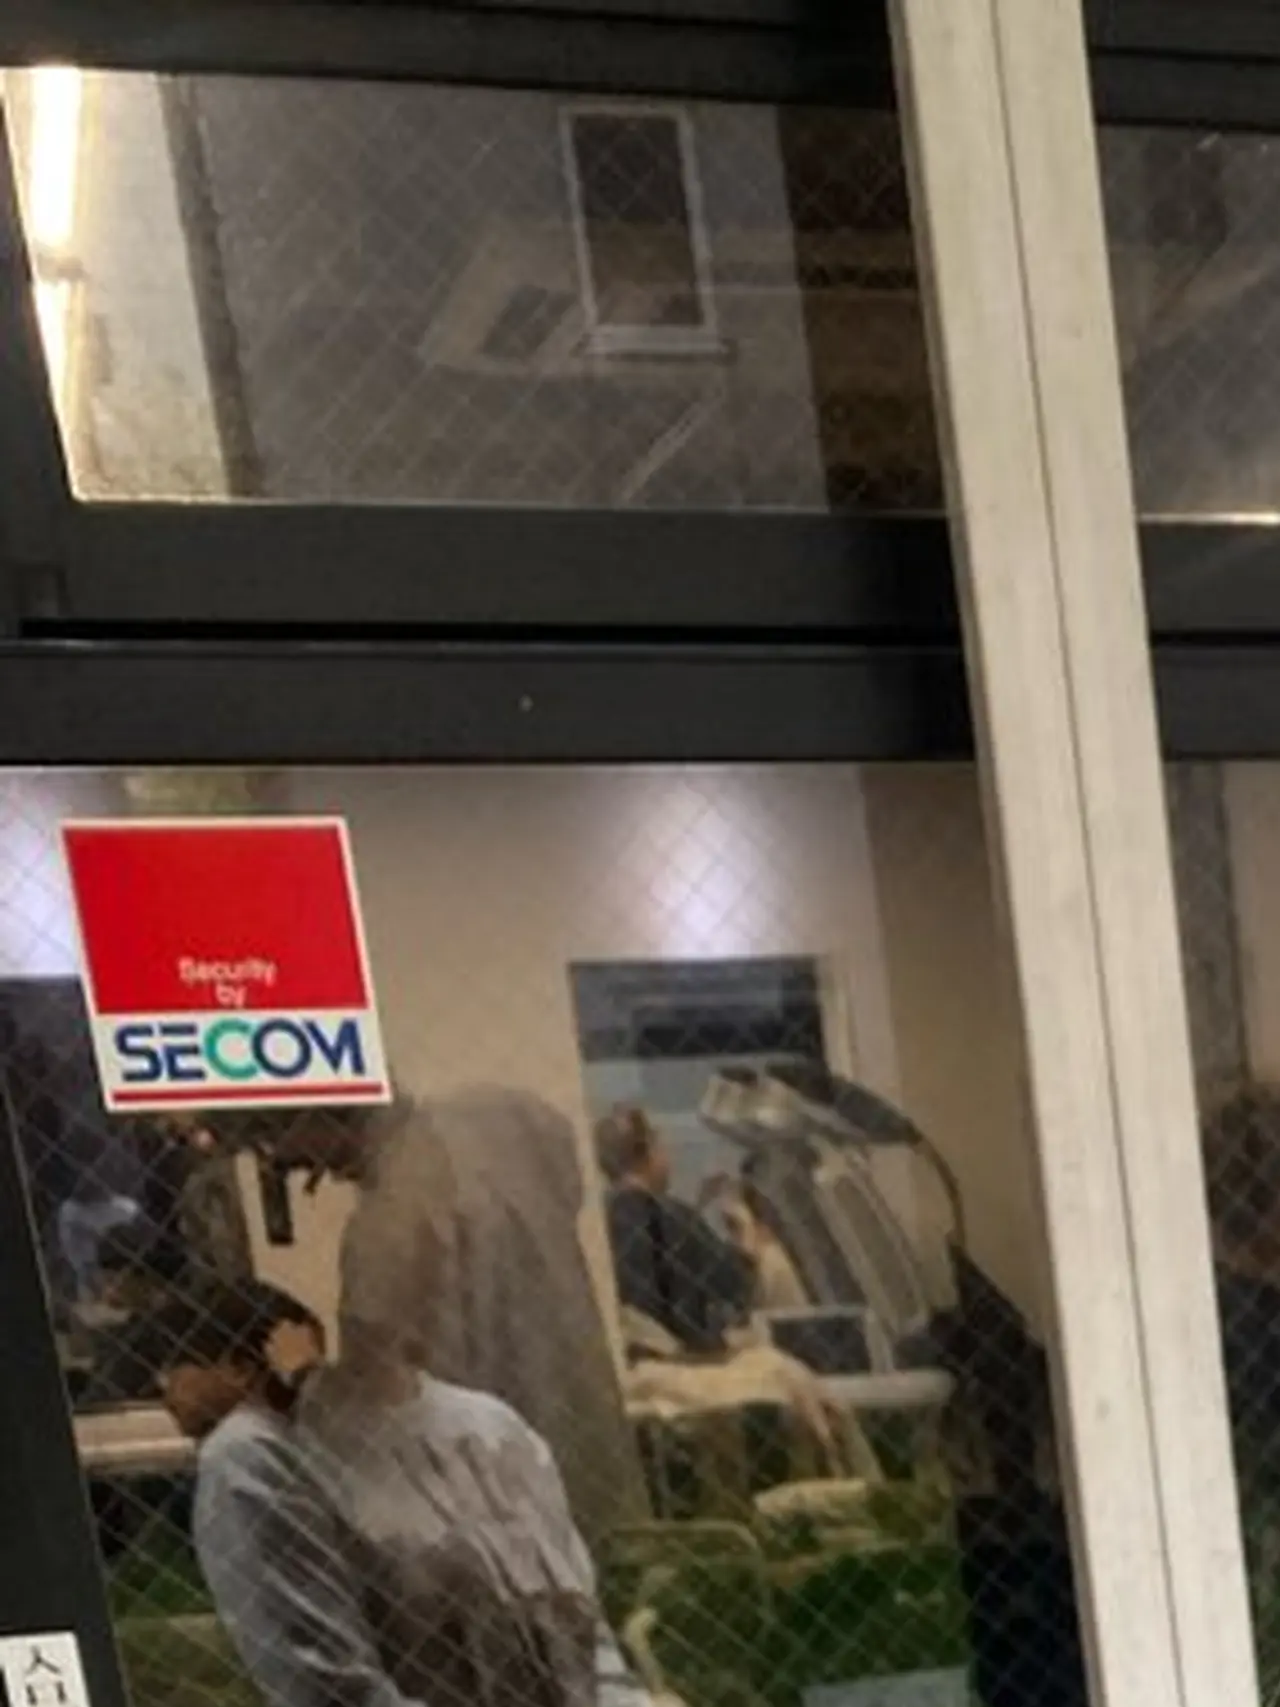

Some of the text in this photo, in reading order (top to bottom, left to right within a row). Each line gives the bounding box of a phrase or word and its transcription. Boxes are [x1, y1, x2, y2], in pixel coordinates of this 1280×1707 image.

[178, 957, 278, 987] Security
[215, 984, 247, 1007] by
[114, 1018, 366, 1081] SECOM
